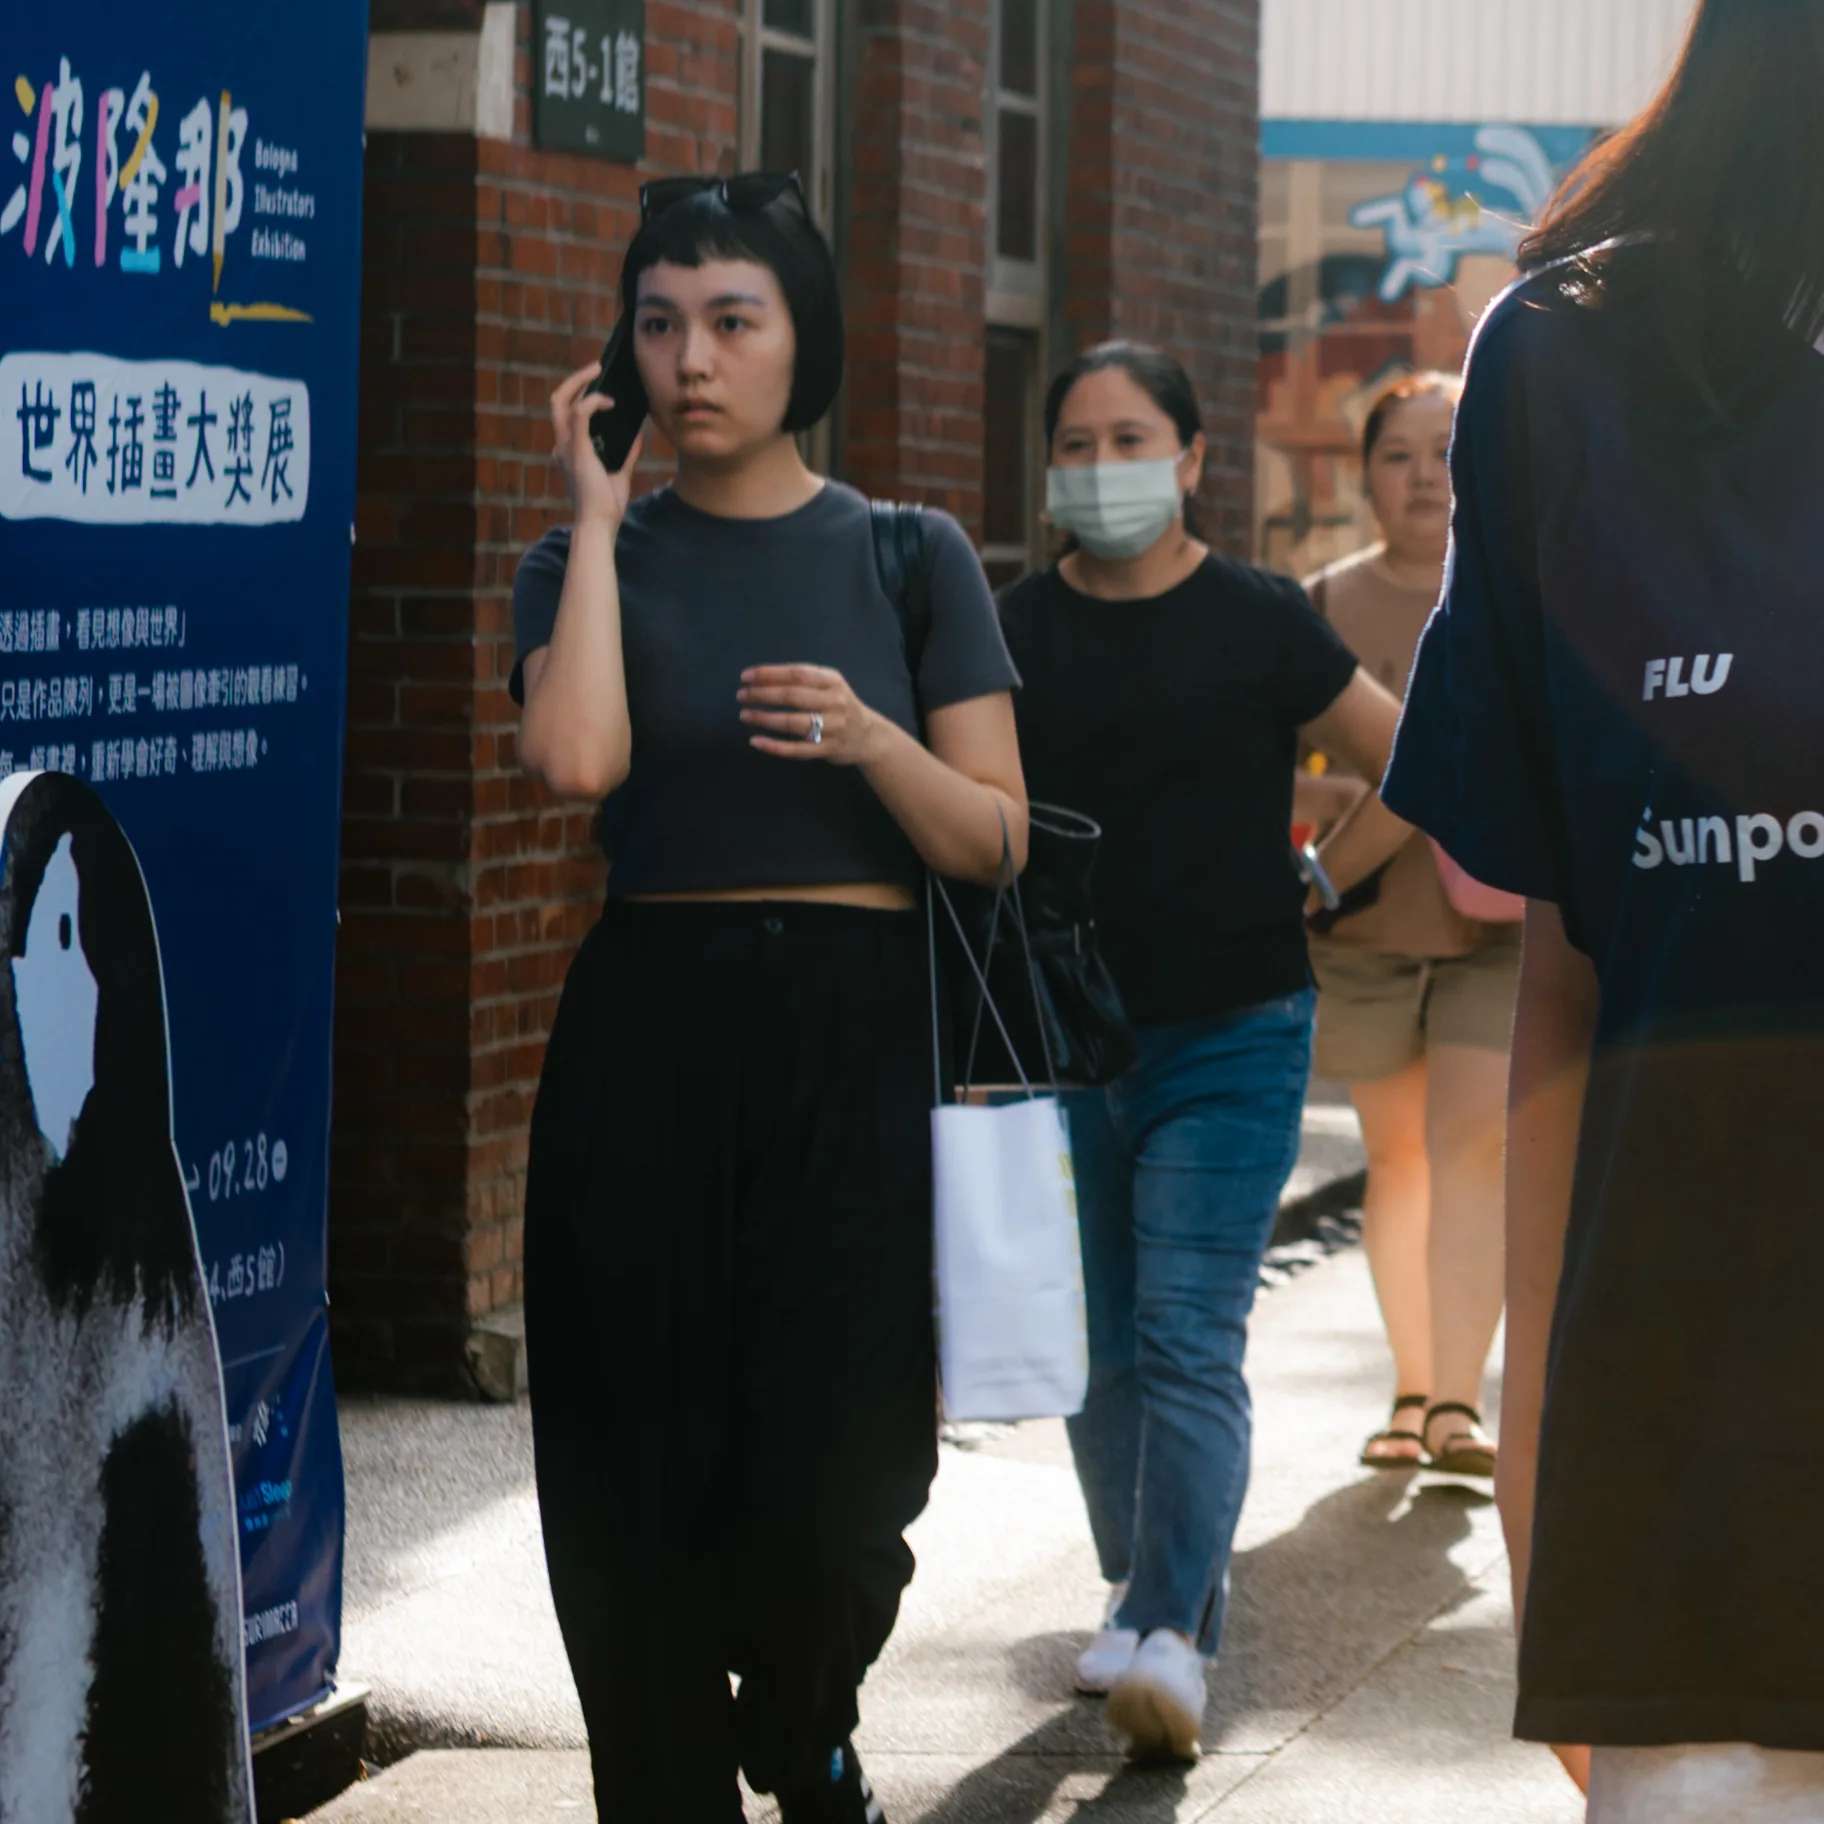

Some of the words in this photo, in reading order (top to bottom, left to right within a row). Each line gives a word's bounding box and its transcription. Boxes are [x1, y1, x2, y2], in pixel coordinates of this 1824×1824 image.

[0, 54, 249, 292] 波隆那
[255, 137, 298, 179] Bologna
[254, 183, 315, 219] Illustrators
[251, 225, 306, 261] Exhibition
[1642, 652, 1734, 702] FLU
